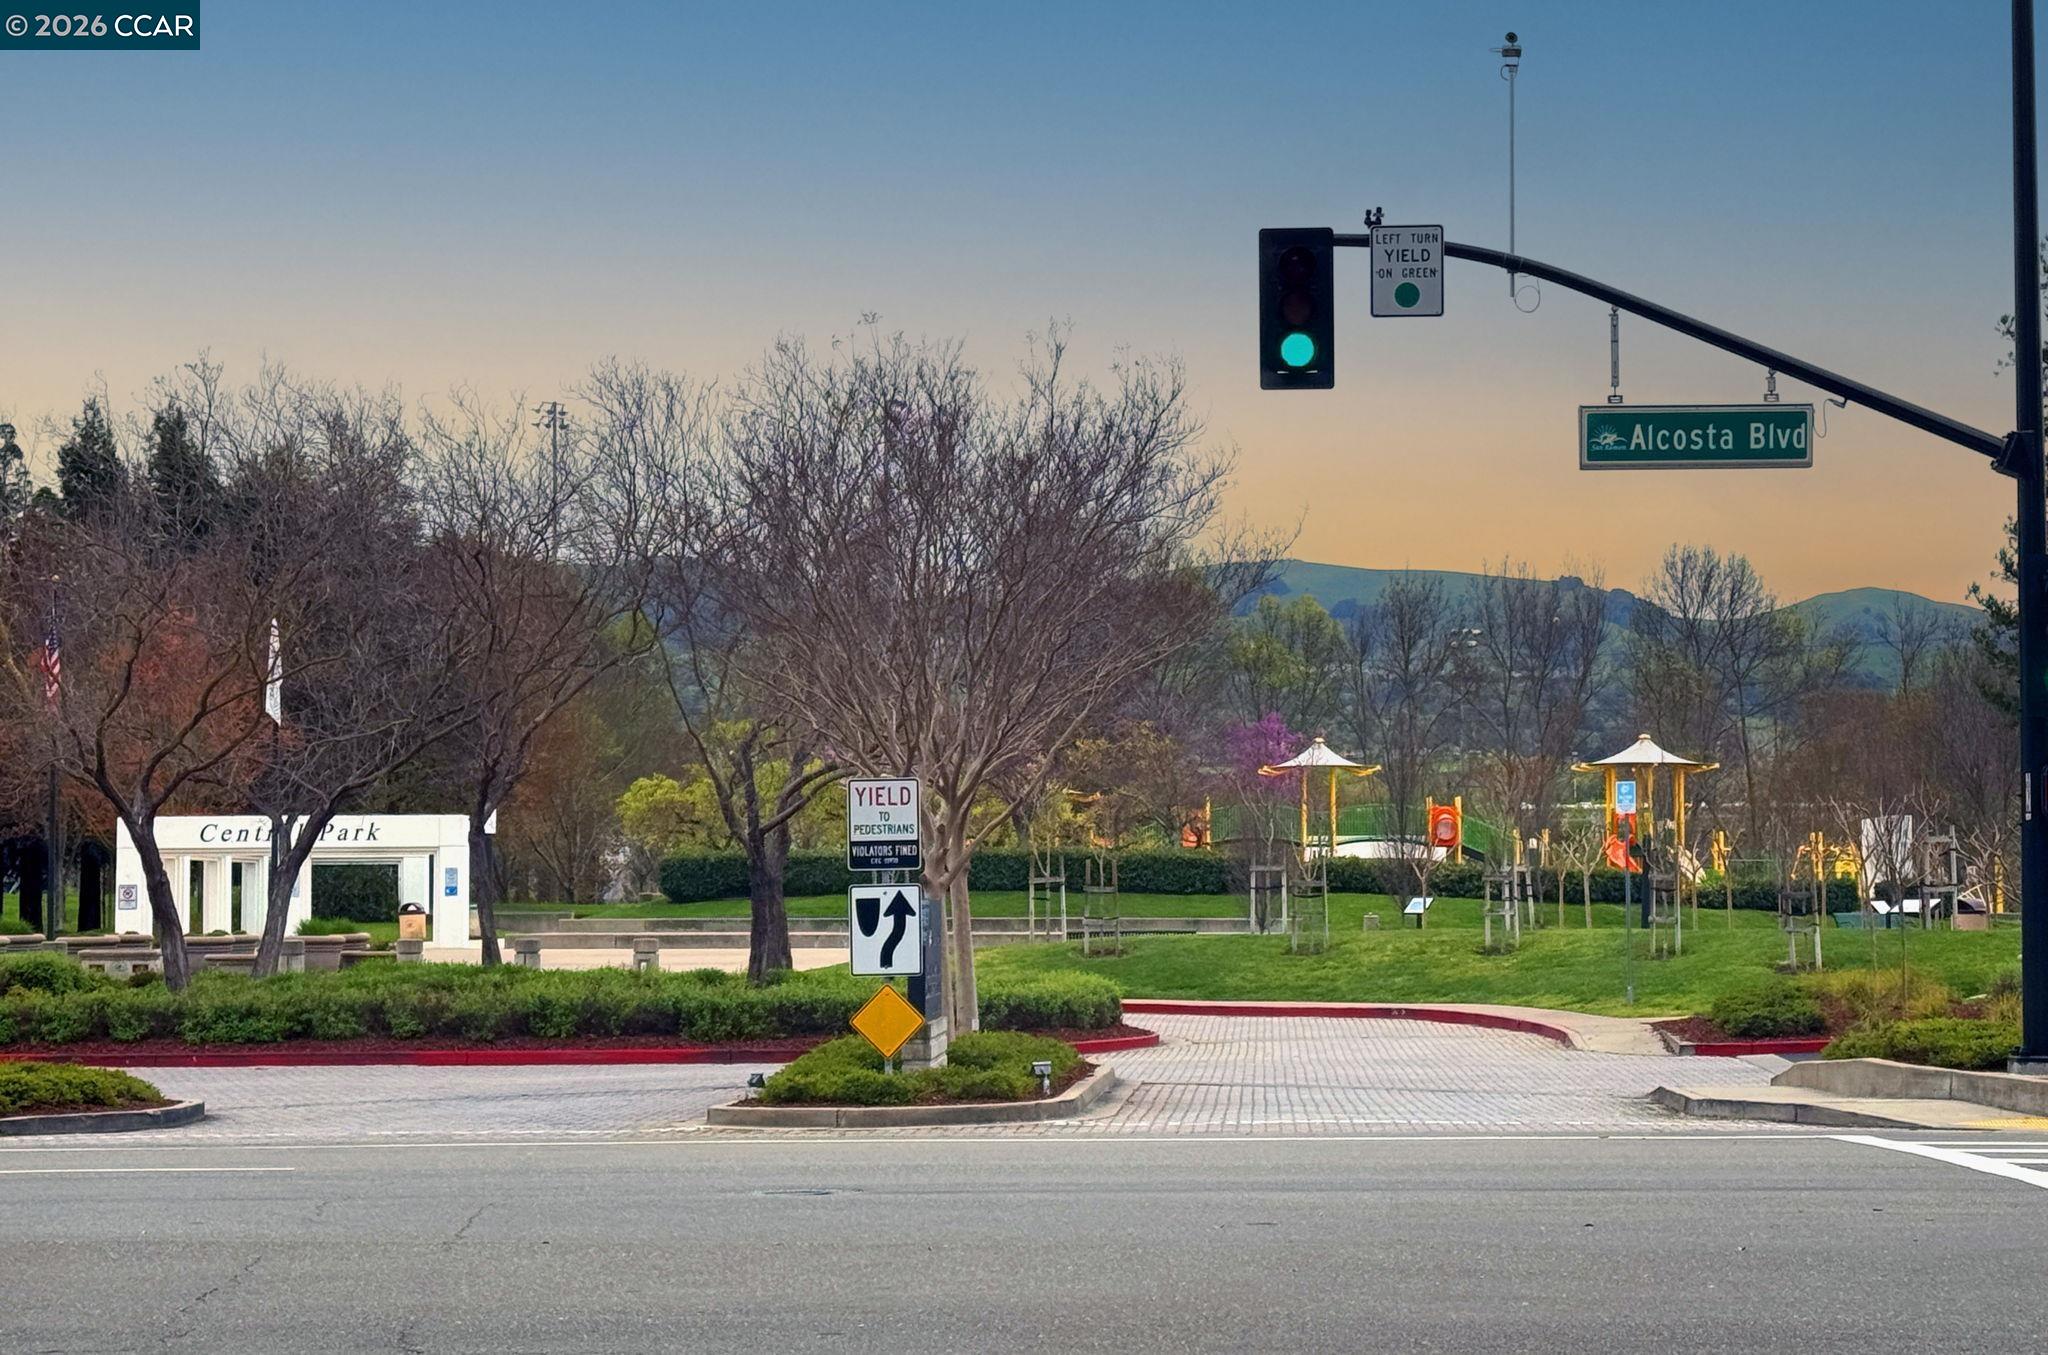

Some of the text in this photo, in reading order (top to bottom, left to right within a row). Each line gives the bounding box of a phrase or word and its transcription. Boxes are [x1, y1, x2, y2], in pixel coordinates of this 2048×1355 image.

[1376, 233, 1438, 244] LEFT TURN
[1384, 248, 1431, 263] YIELD
[1378, 267, 1437, 279] ON GREEN
[1629, 422, 1806, 451] Alcosta Blvd
[855, 786, 911, 807] YIELD
[879, 811, 890, 822] TO
[319, 822, 382, 842] Park
[853, 824, 915, 835] PEDESTRIANS
[852, 845, 917, 857] VIOLATORS FINED
